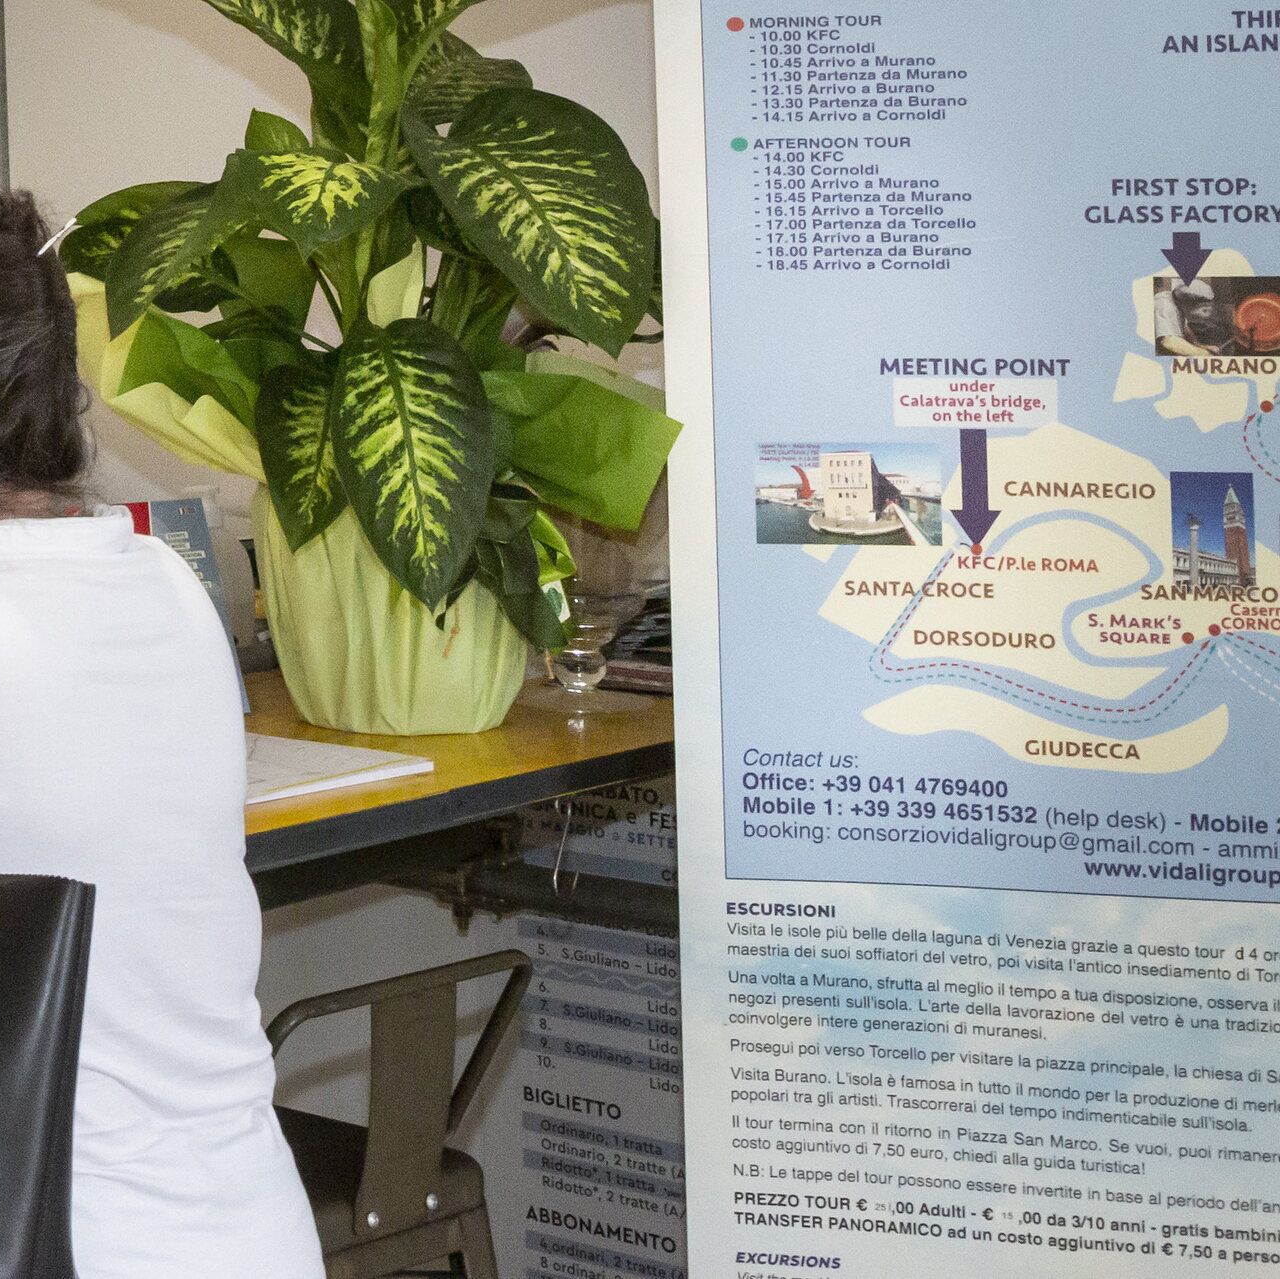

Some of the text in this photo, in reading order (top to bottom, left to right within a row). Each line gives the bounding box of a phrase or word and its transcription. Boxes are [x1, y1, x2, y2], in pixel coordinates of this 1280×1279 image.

[750, 16, 882, 28] MORNING TOUR
[761, 30, 840, 41] 10.00 KFC
[761, 56, 936, 68] 10.45 Arrivo a Murano
[754, 137, 911, 149] AFTERNOON TOUR
[1112, 178, 1257, 196] FIRST STOP:
[1085, 206, 1163, 223] GLASS
[880, 359, 1070, 376] MEETING POINT
[1172, 359, 1276, 374] MURANO
[950, 380, 995, 392] under
[991, 396, 1047, 410] bridge,
[932, 410, 1014, 422] on the left
[1004, 481, 1156, 499] CANNAREGIO
[1042, 558, 1099, 572] ROMA
[845, 581, 994, 598] SANTA CROCE
[1142, 585, 1278, 603] SAN MARCO
[1089, 613, 1104, 627] S.
[913, 629, 1056, 650] DORSODURO
[1100, 632, 1171, 644] SQUARE
[743, 748, 859, 768] Contact us:
[1025, 740, 1140, 759] GIUDECCA
[743, 773, 1008, 798] Office: +39 041 4769400
[743, 821, 1194, 856] booking: consorziovidaligroup@gmail.com
[726, 903, 835, 918] ESCURSIONI
[727, 923, 927, 942] Visita le isole più belle della
[561, 948, 677, 978] S.Giuliano Lido
[524, 1086, 621, 1119] BIGLIETTO
[526, 1206, 676, 1253] ABBONAMENTO
[736, 1252, 840, 1269] EXCURSIONS
